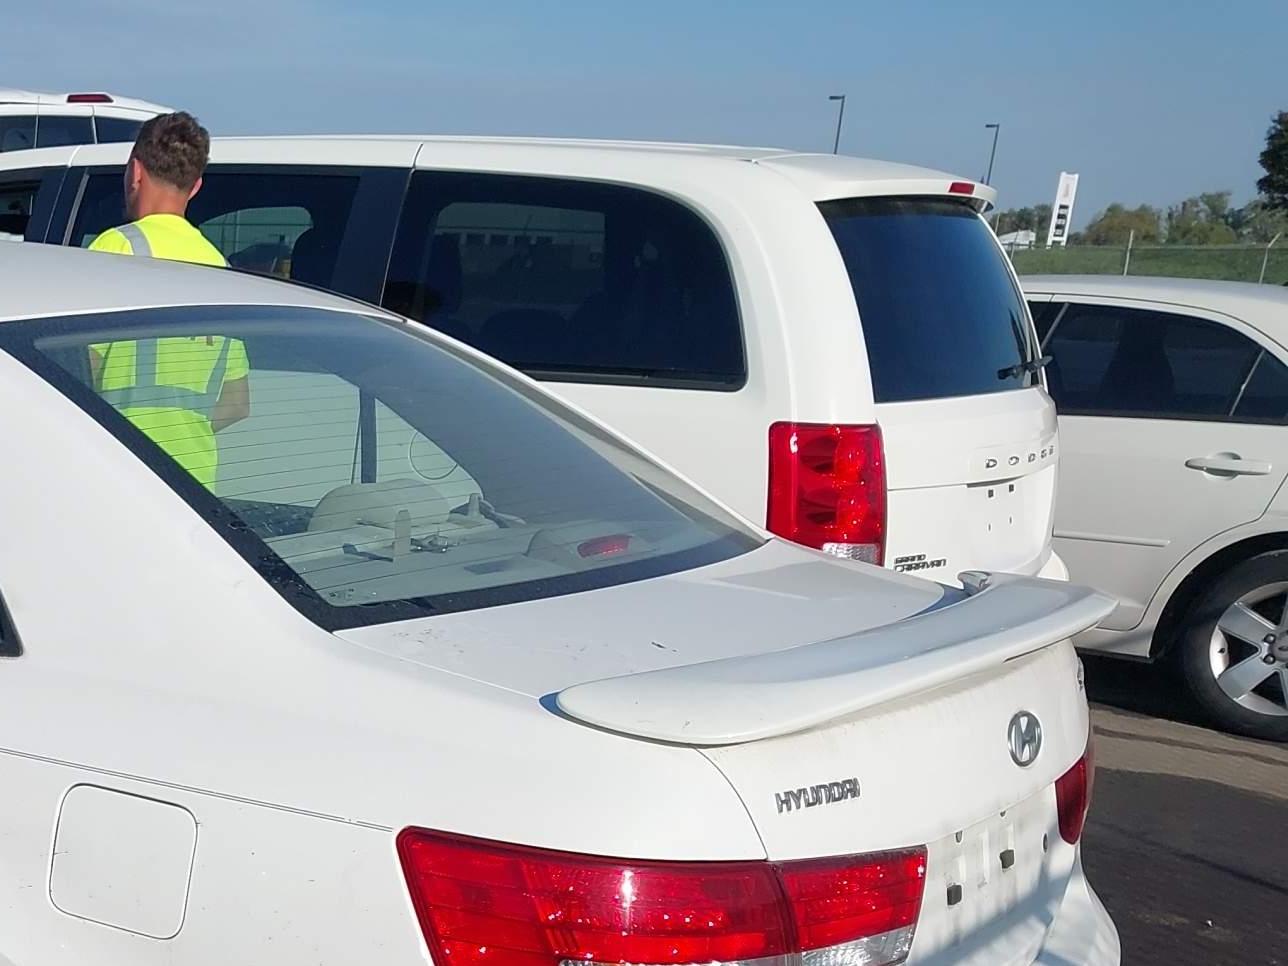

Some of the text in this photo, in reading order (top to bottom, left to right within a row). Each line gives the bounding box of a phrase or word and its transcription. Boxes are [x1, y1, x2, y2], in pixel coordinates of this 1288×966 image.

[984, 445, 1055, 469] DODGE
[894, 553, 926, 564] GRAND
[894, 558, 947, 572] CARAVAN
[774, 777, 861, 813] HYUNDAI
